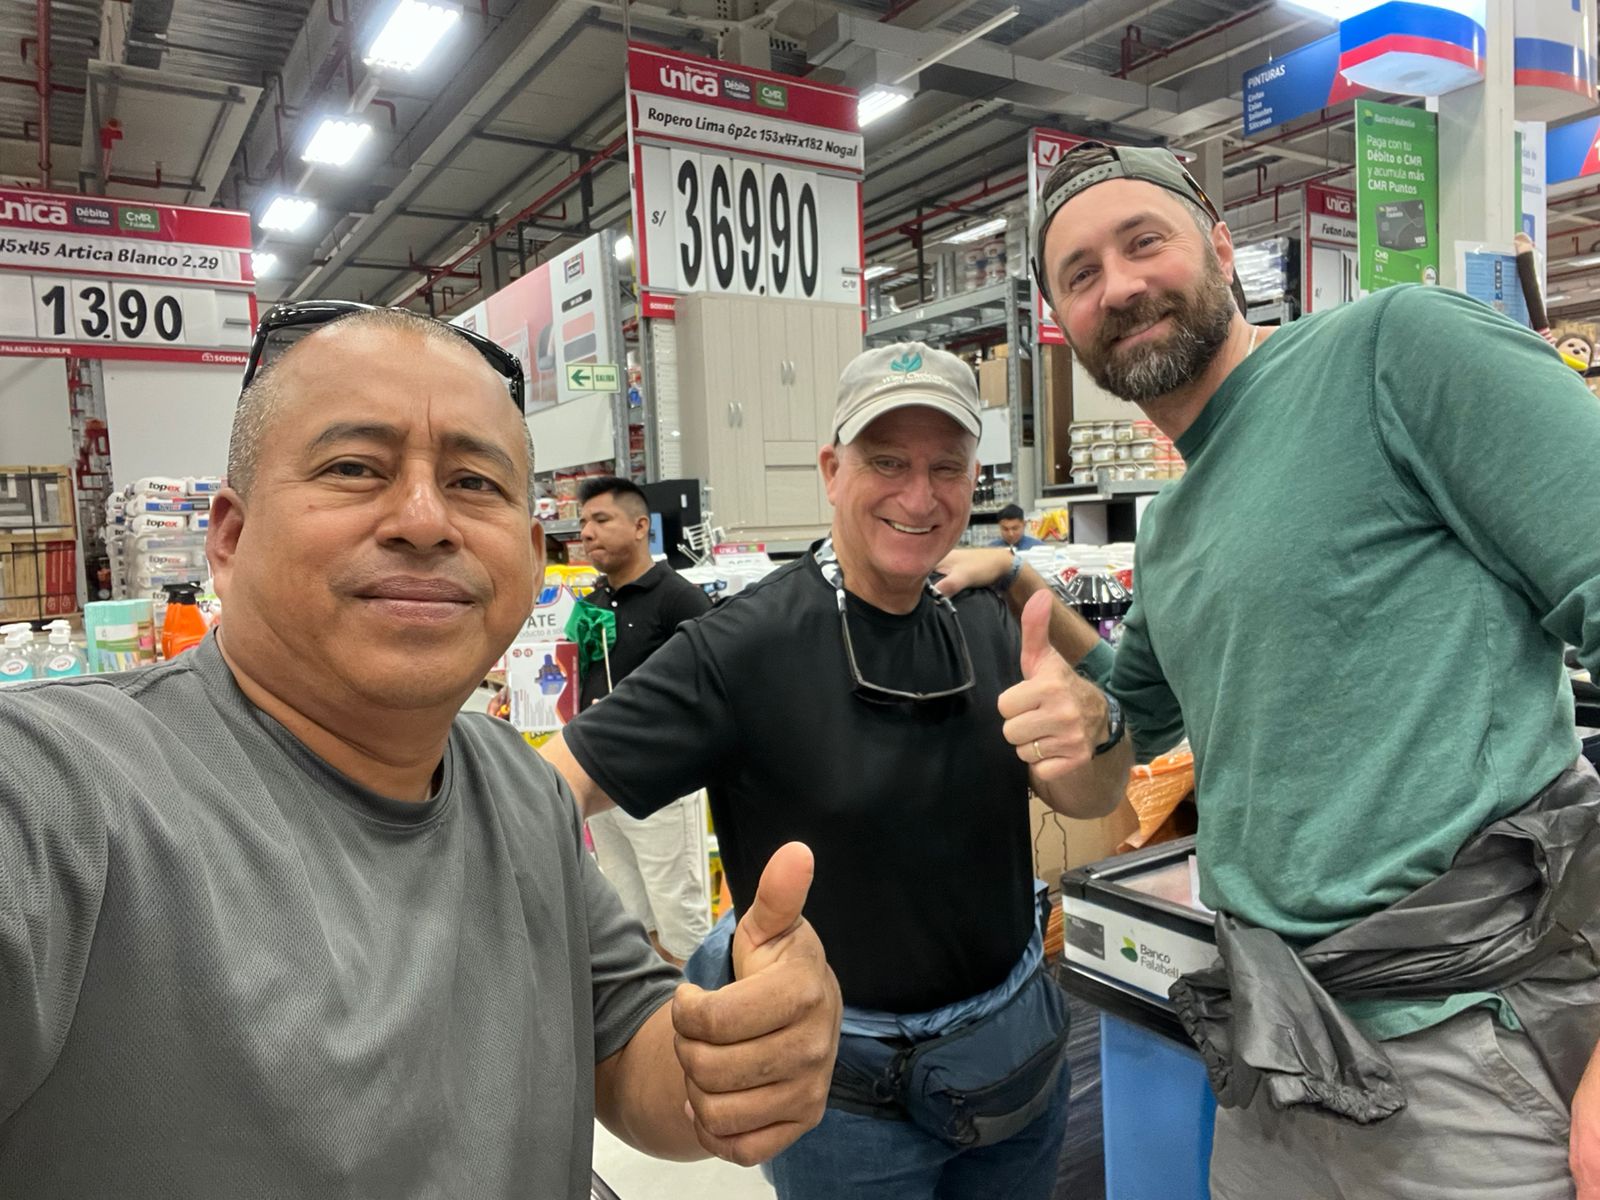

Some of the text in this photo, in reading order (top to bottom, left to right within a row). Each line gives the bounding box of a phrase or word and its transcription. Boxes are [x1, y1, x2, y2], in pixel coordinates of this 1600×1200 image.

[659, 64, 718, 97] única
[1247, 64, 1285, 88] PINTURAS
[724, 78, 750, 93] Débito
[761, 86, 782, 101] CMR
[648, 107, 858, 159] Ropero Lima 6p2c 153x47x182 Nogal
[1366, 134, 1412, 151] Paga con tu
[1367, 149, 1423, 167] Débito o CMR
[1367, 167, 1425, 181] y acumula más
[1368, 179, 1417, 195] CMR Puntos
[75, 206, 110, 219] Débito
[125, 211, 152, 224] CMR
[651, 210, 667, 227] S/
[677, 159, 819, 298] 369.90
[54, 243, 113, 263] Artica
[117, 248, 178, 268] Blanco
[181, 254, 219, 270] 2.29
[41, 285, 183, 341] 13.90
[214, 354, 248, 363] SODIMA
[148, 482, 181, 493] topex
[146, 519, 178, 529] topex
[1140, 943, 1171, 965] Banco
